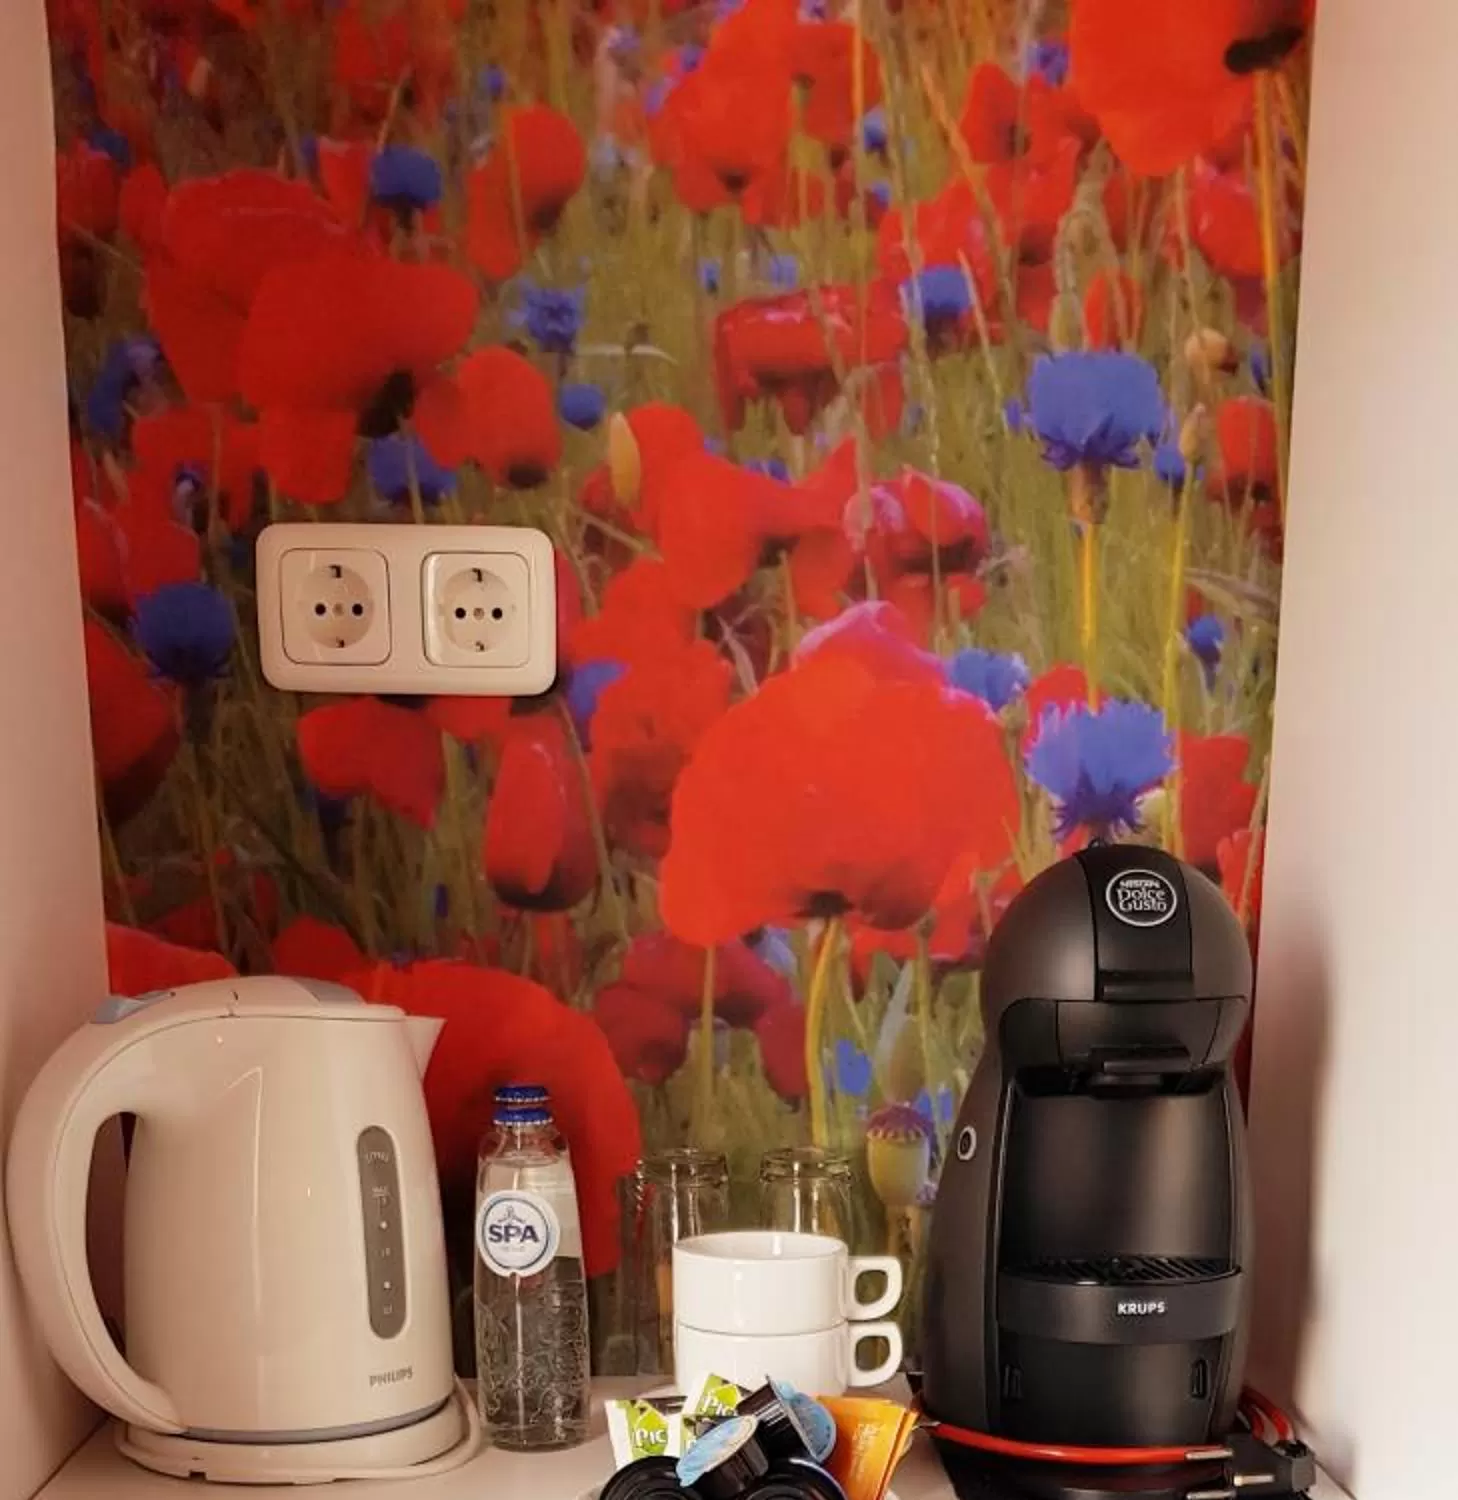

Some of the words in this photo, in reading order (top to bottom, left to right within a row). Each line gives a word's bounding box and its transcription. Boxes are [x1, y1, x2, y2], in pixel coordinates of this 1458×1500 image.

[1116, 887, 1166, 901] Dolce
[1119, 899, 1167, 912] Gusto
[488, 1223, 540, 1244] SPA
[1117, 1300, 1166, 1315] KRUPS
[368, 1365, 413, 1388] PHILIPS
